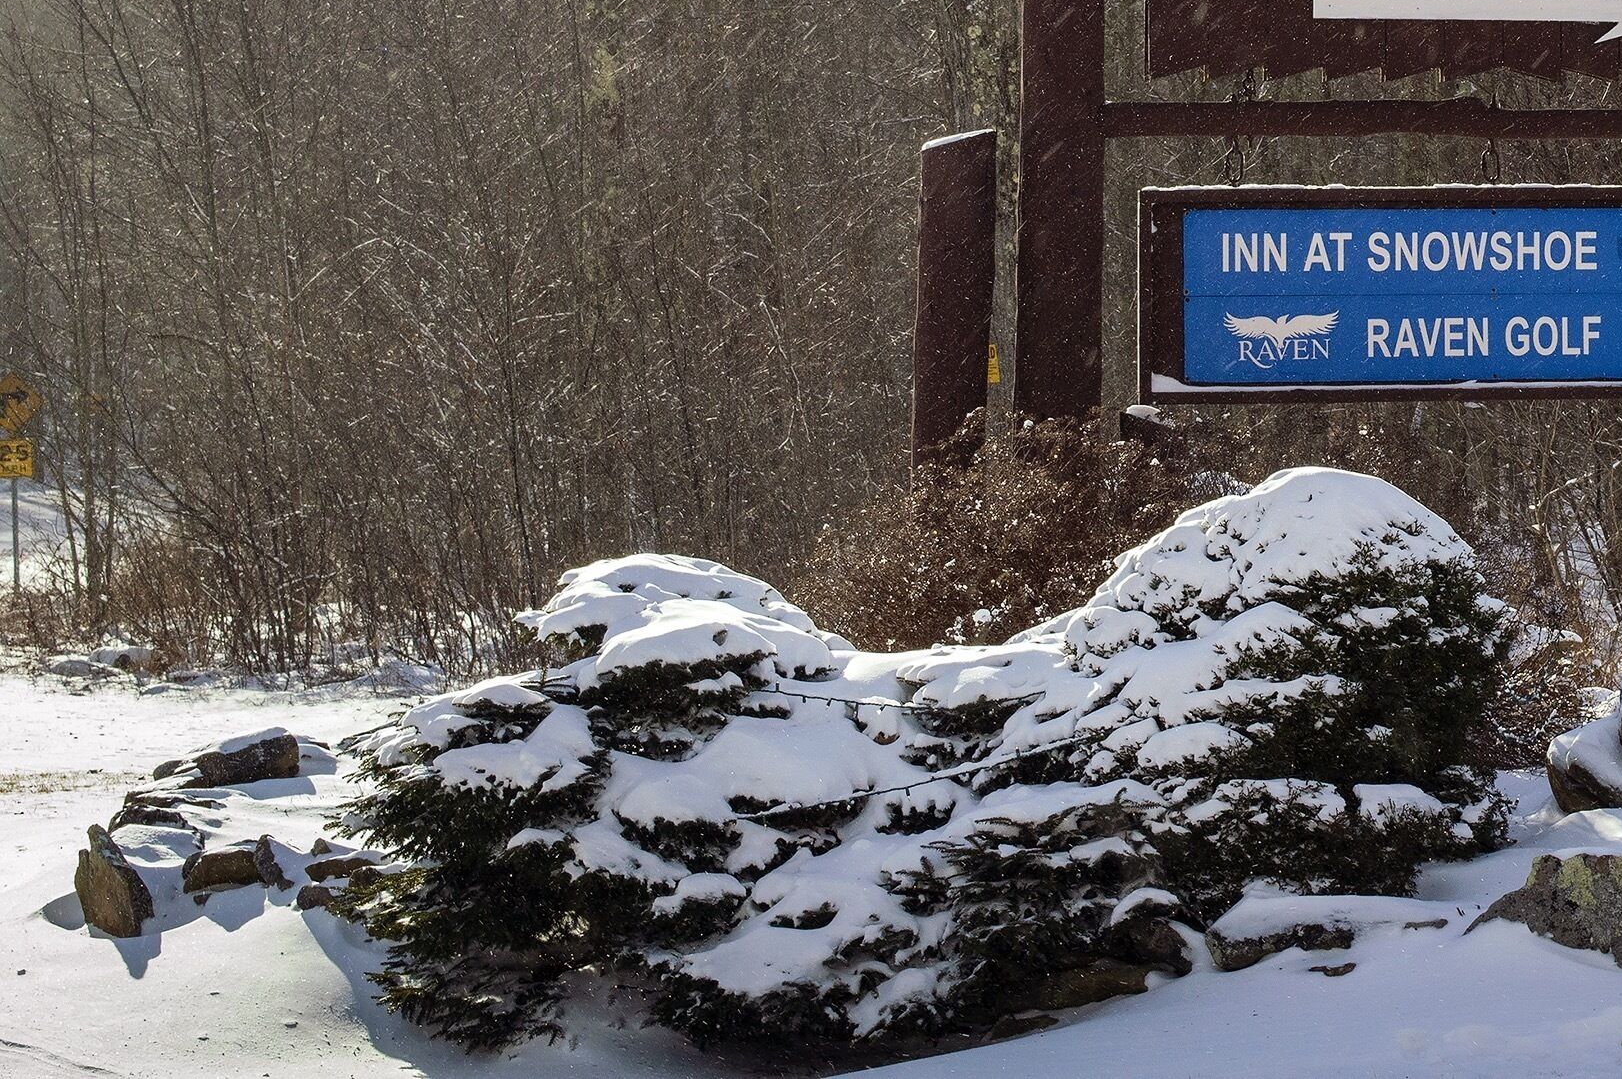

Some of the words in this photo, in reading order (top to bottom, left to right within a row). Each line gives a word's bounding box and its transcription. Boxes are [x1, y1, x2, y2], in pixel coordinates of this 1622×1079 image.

[1221, 232, 1288, 273] INN
[1304, 232, 1353, 272] AT
[1367, 230, 1598, 272] SNOWSHOE
[1238, 338, 1331, 369] RAVEN
[1367, 318, 1489, 358] RAVEN
[1504, 316, 1602, 357] GOLF
